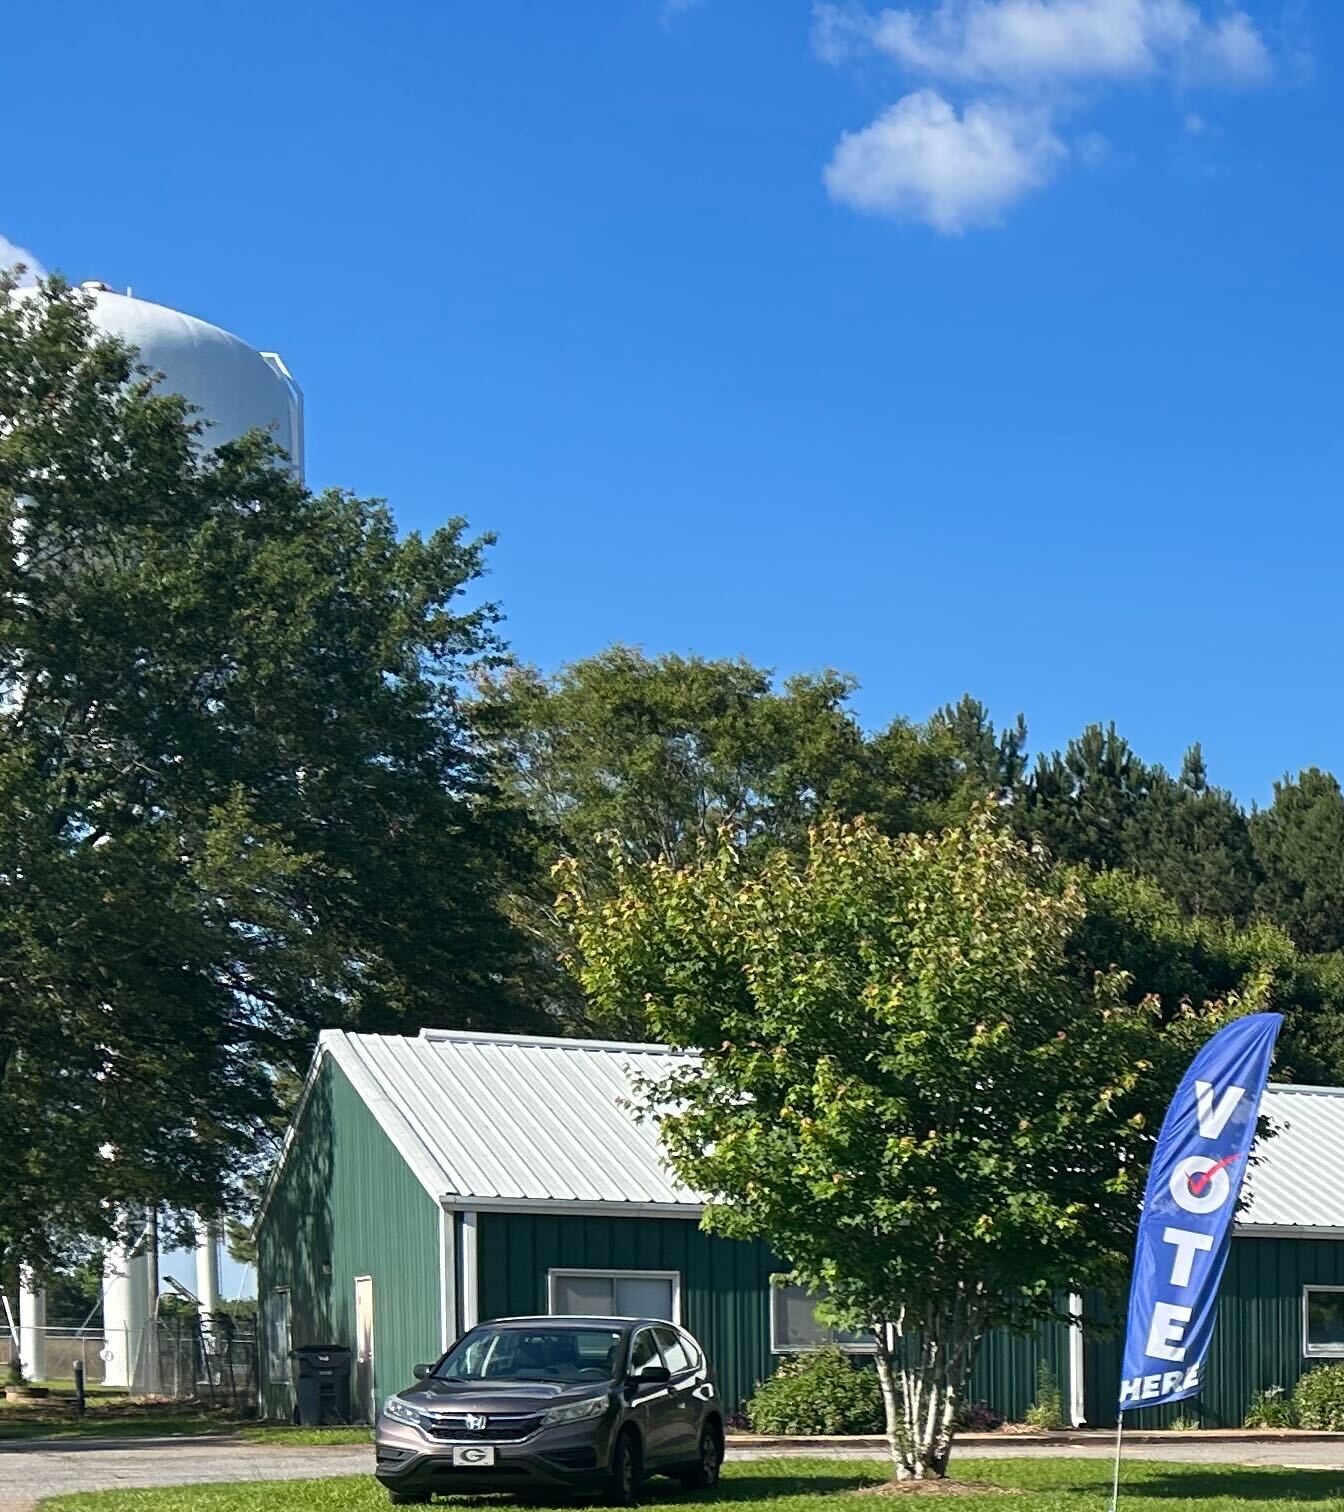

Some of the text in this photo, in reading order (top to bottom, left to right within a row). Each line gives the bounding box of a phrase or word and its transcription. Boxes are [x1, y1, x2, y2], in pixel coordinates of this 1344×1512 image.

[1145, 1081, 1245, 1361] VOTE
[1120, 1363, 1200, 1399] HERE
[461, 1448, 486, 1463] G
